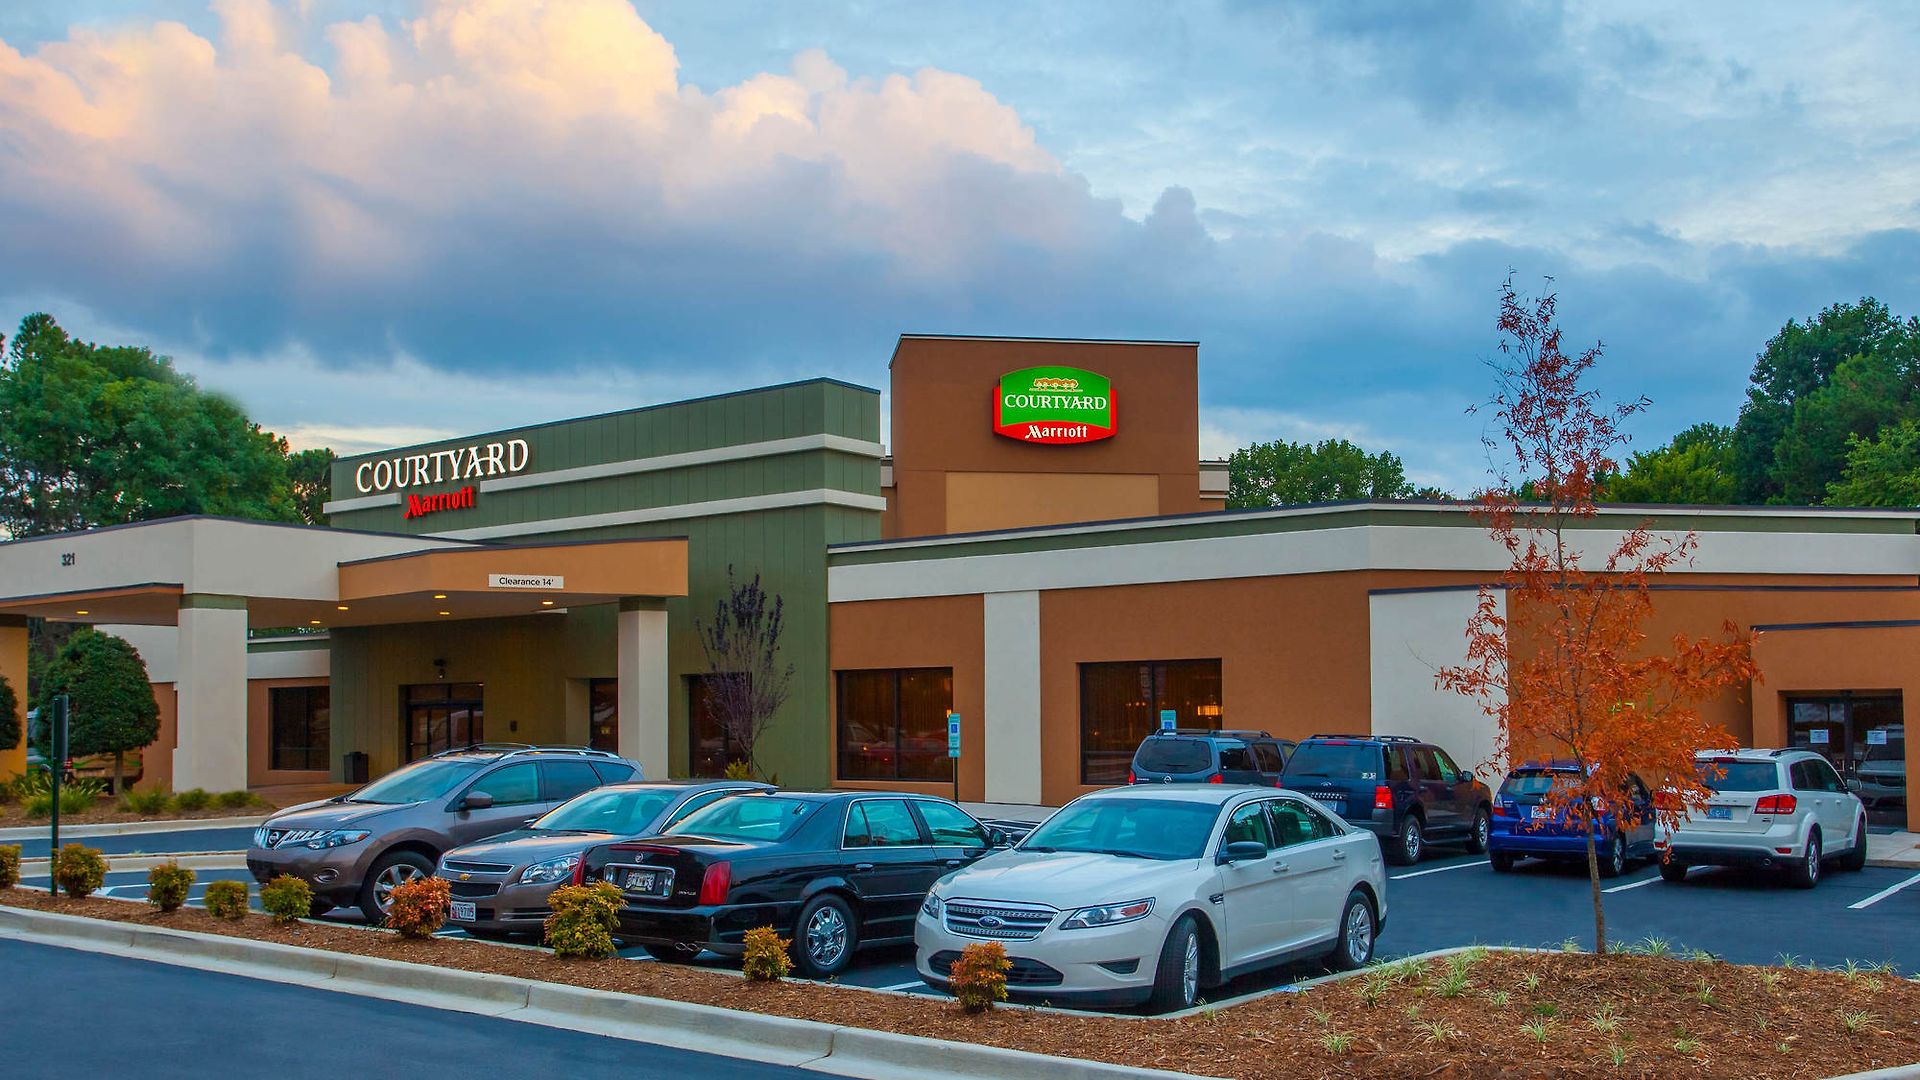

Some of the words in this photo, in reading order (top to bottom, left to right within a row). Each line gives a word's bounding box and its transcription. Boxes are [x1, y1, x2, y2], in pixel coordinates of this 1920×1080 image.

[1004, 394, 1107, 410] COURTYARD
[1025, 425, 1088, 439] Marriott
[356, 439, 529, 492] COURTYARD
[404, 487, 474, 518] Marriott
[61, 552, 76, 566] 321
[498, 576, 541, 586] Clearance
[542, 577, 554, 587] 14'
